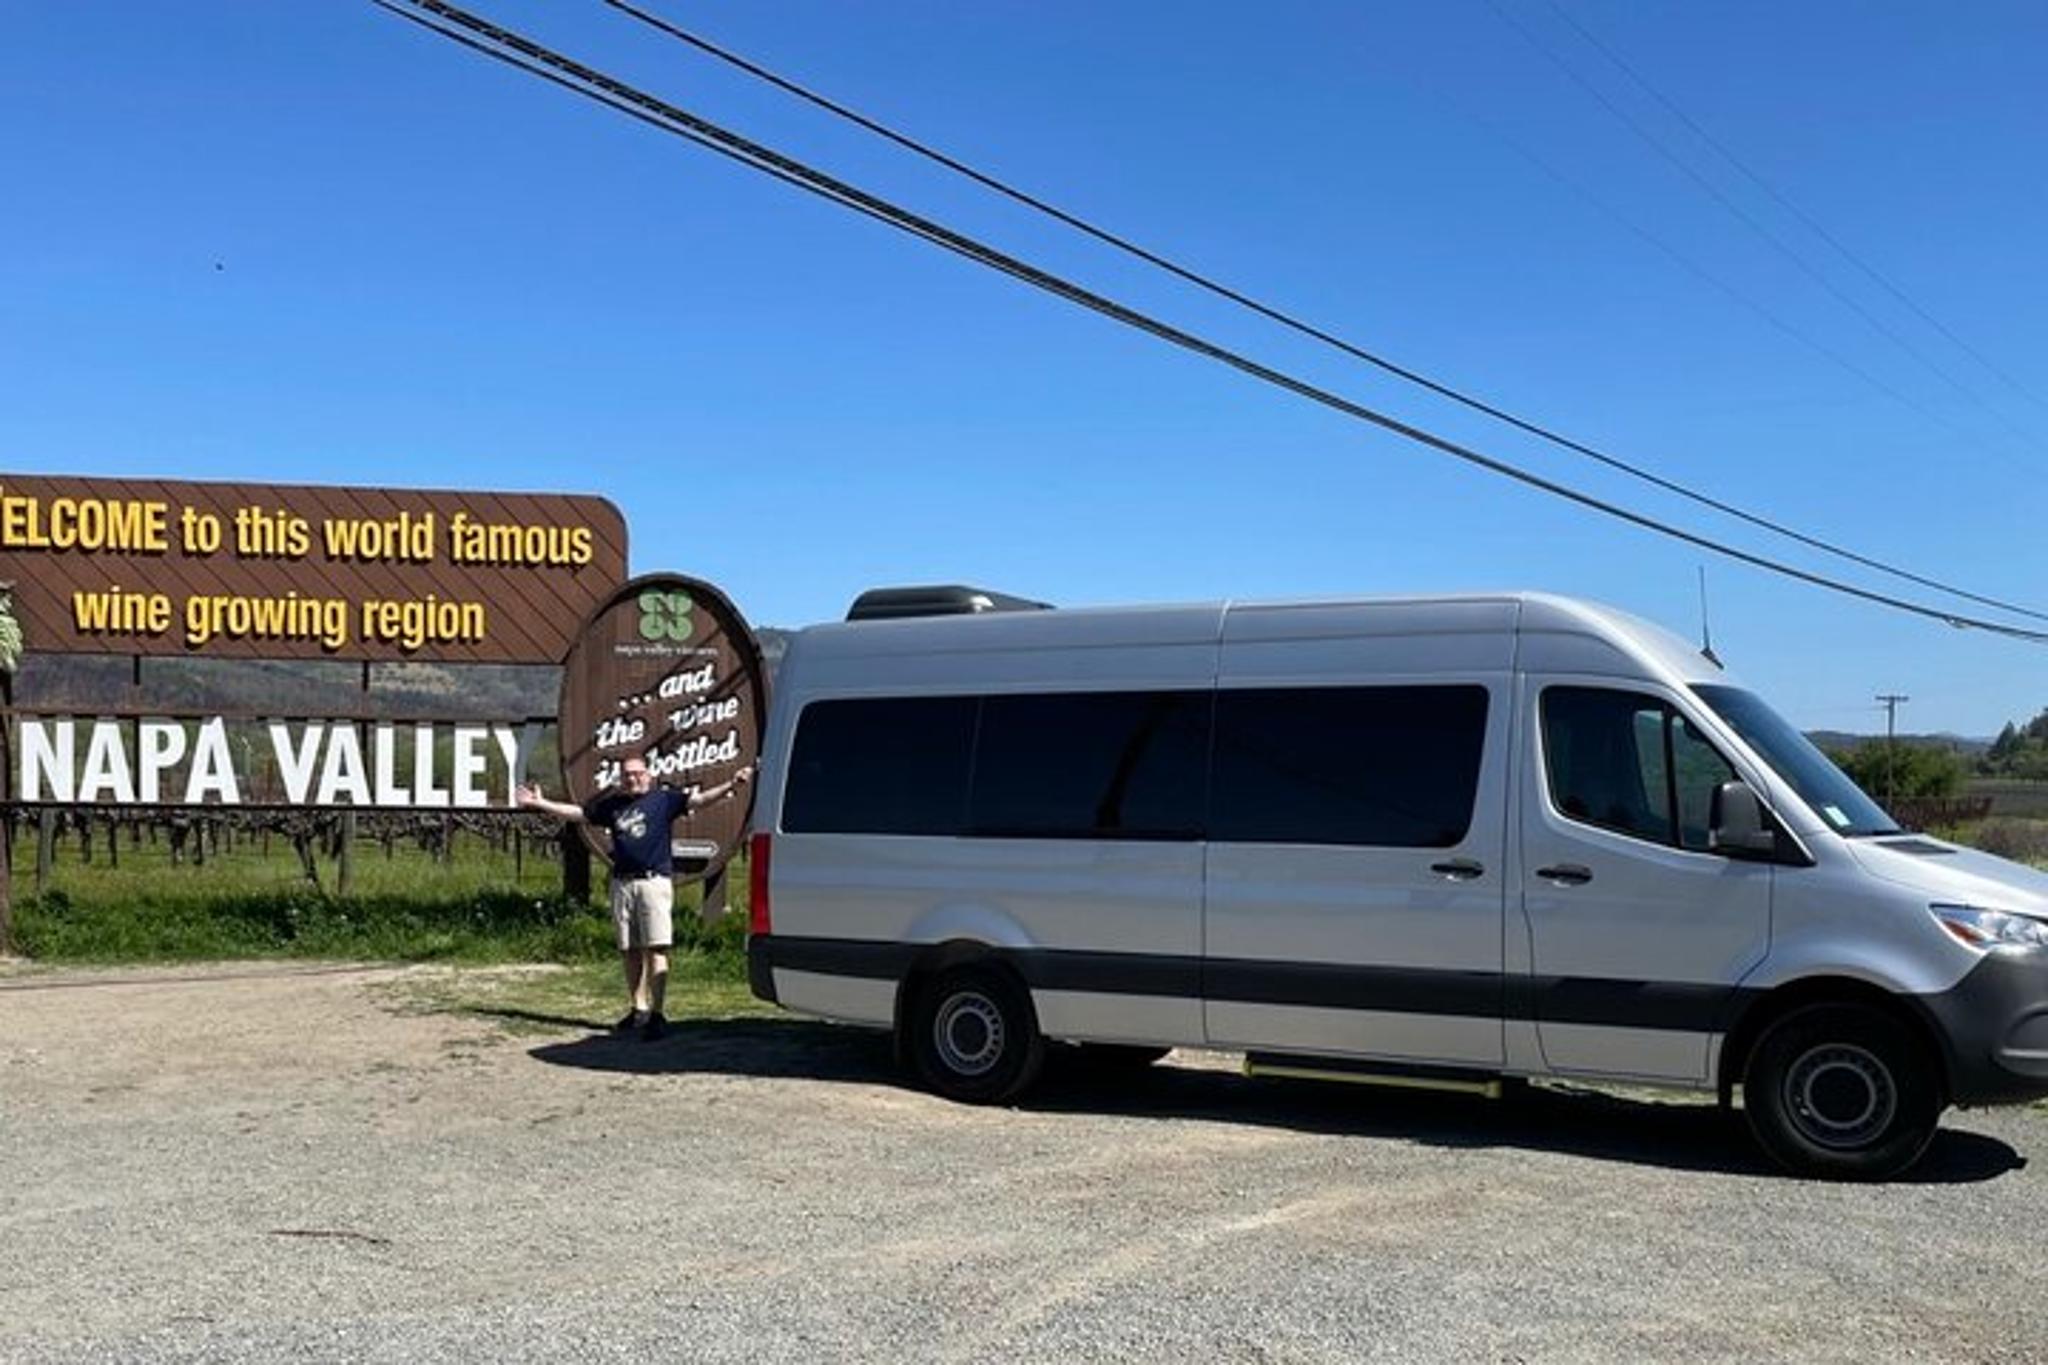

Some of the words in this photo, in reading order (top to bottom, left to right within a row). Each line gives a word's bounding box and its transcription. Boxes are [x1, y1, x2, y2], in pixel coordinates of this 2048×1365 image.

[0, 488, 169, 550] ELCOME
[182, 506, 221, 552] to
[236, 506, 310, 556] this
[324, 511, 434, 559] world
[451, 513, 593, 564] famous
[73, 584, 171, 632] wine
[186, 591, 347, 648] growing
[362, 594, 485, 649] region
[596, 717, 644, 748] the
[668, 695, 738, 731] wine
[645, 730, 739, 777] bottled
[20, 713, 241, 804] NAPA
[266, 718, 544, 809] VALLEY
